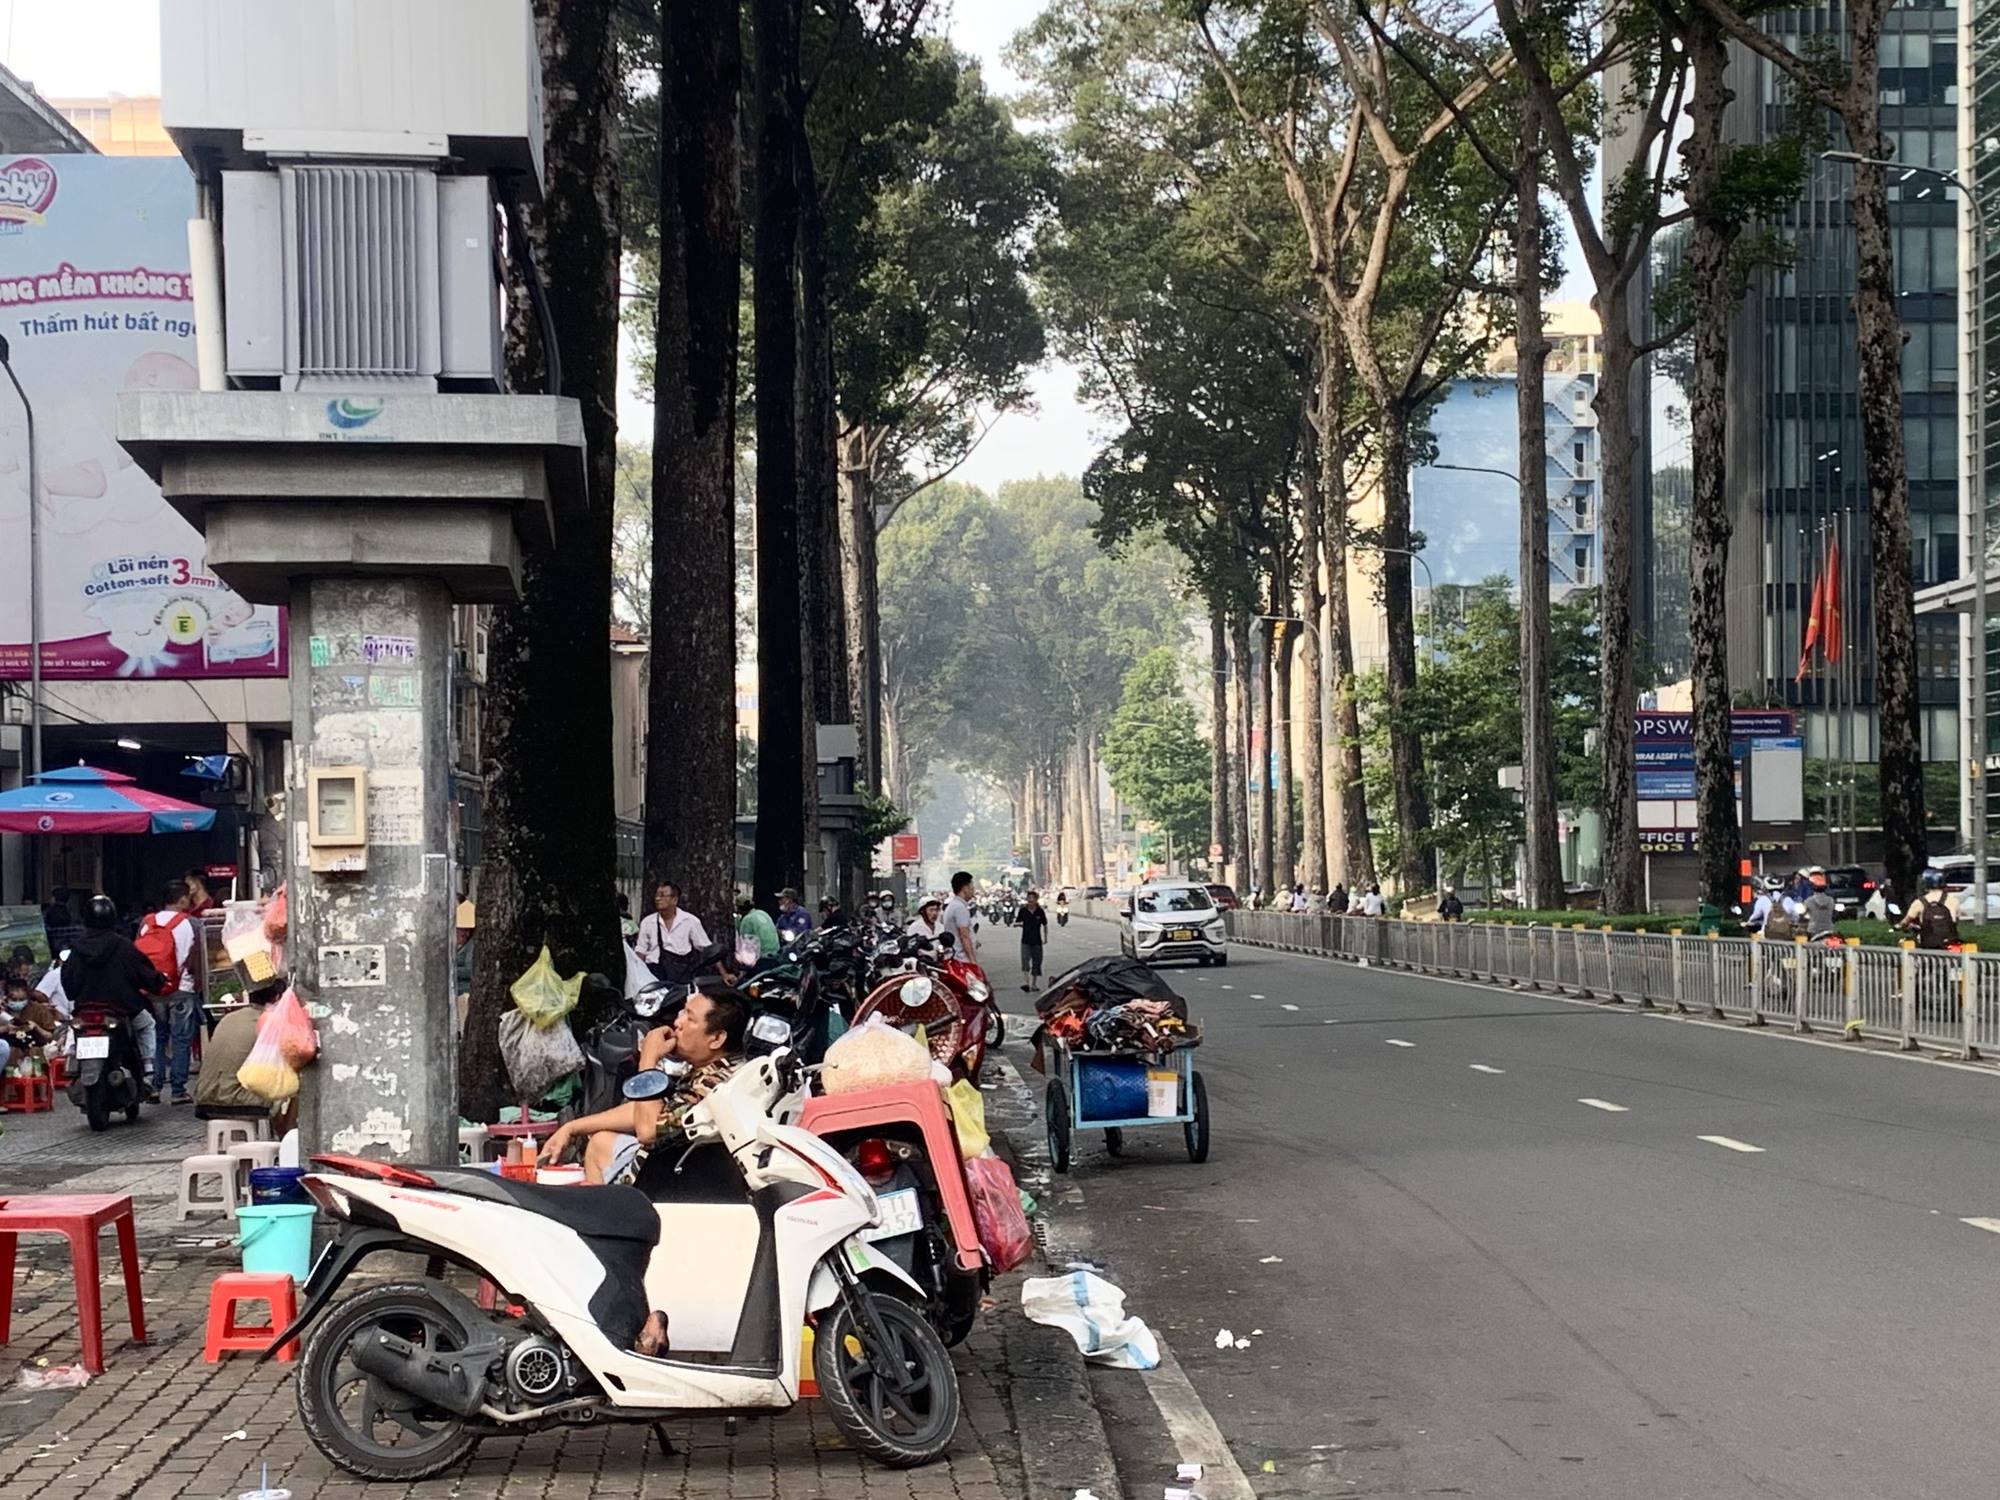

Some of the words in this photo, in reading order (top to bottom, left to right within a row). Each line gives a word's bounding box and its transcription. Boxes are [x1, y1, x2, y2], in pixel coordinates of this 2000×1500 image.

[0, 280, 35, 302] NG
[38, 266, 97, 299] MỀM
[100, 271, 182, 298] KHÔNG
[20, 312, 78, 337] Thấm
[84, 312, 119, 331] hút
[125, 311, 160, 332] bất
[108, 559, 134, 574] Lõi
[138, 555, 169, 571] nén
[172, 558, 191, 586] 3
[191, 576, 216, 589] mm
[84, 574, 169, 596] Cotton-soft
